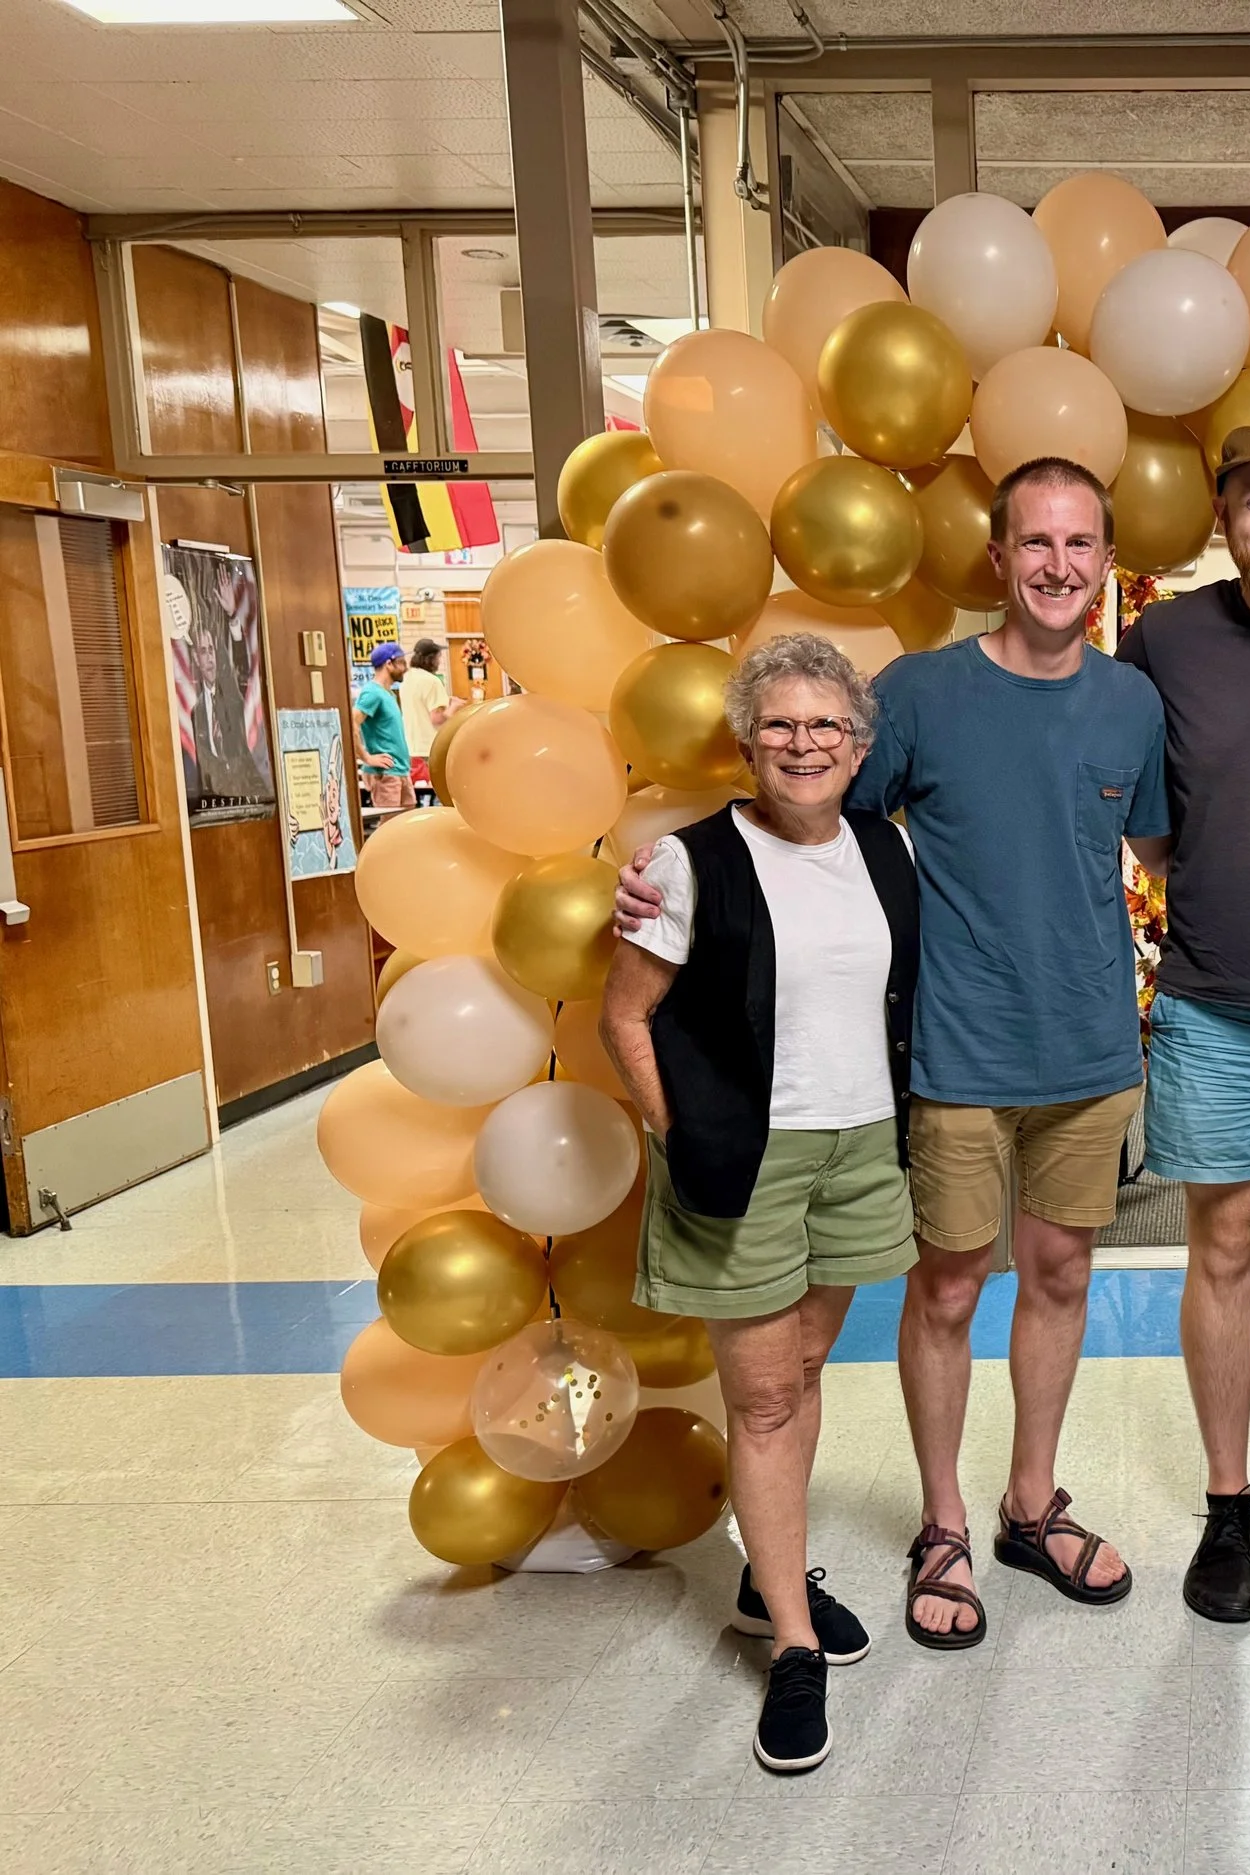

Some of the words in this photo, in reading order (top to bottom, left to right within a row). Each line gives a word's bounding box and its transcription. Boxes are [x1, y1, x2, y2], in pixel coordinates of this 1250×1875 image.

[350, 617, 374, 638] NO
[375, 617, 394, 629] place
[377, 629, 395, 638] for
[201, 795, 260, 809] DESTINY
